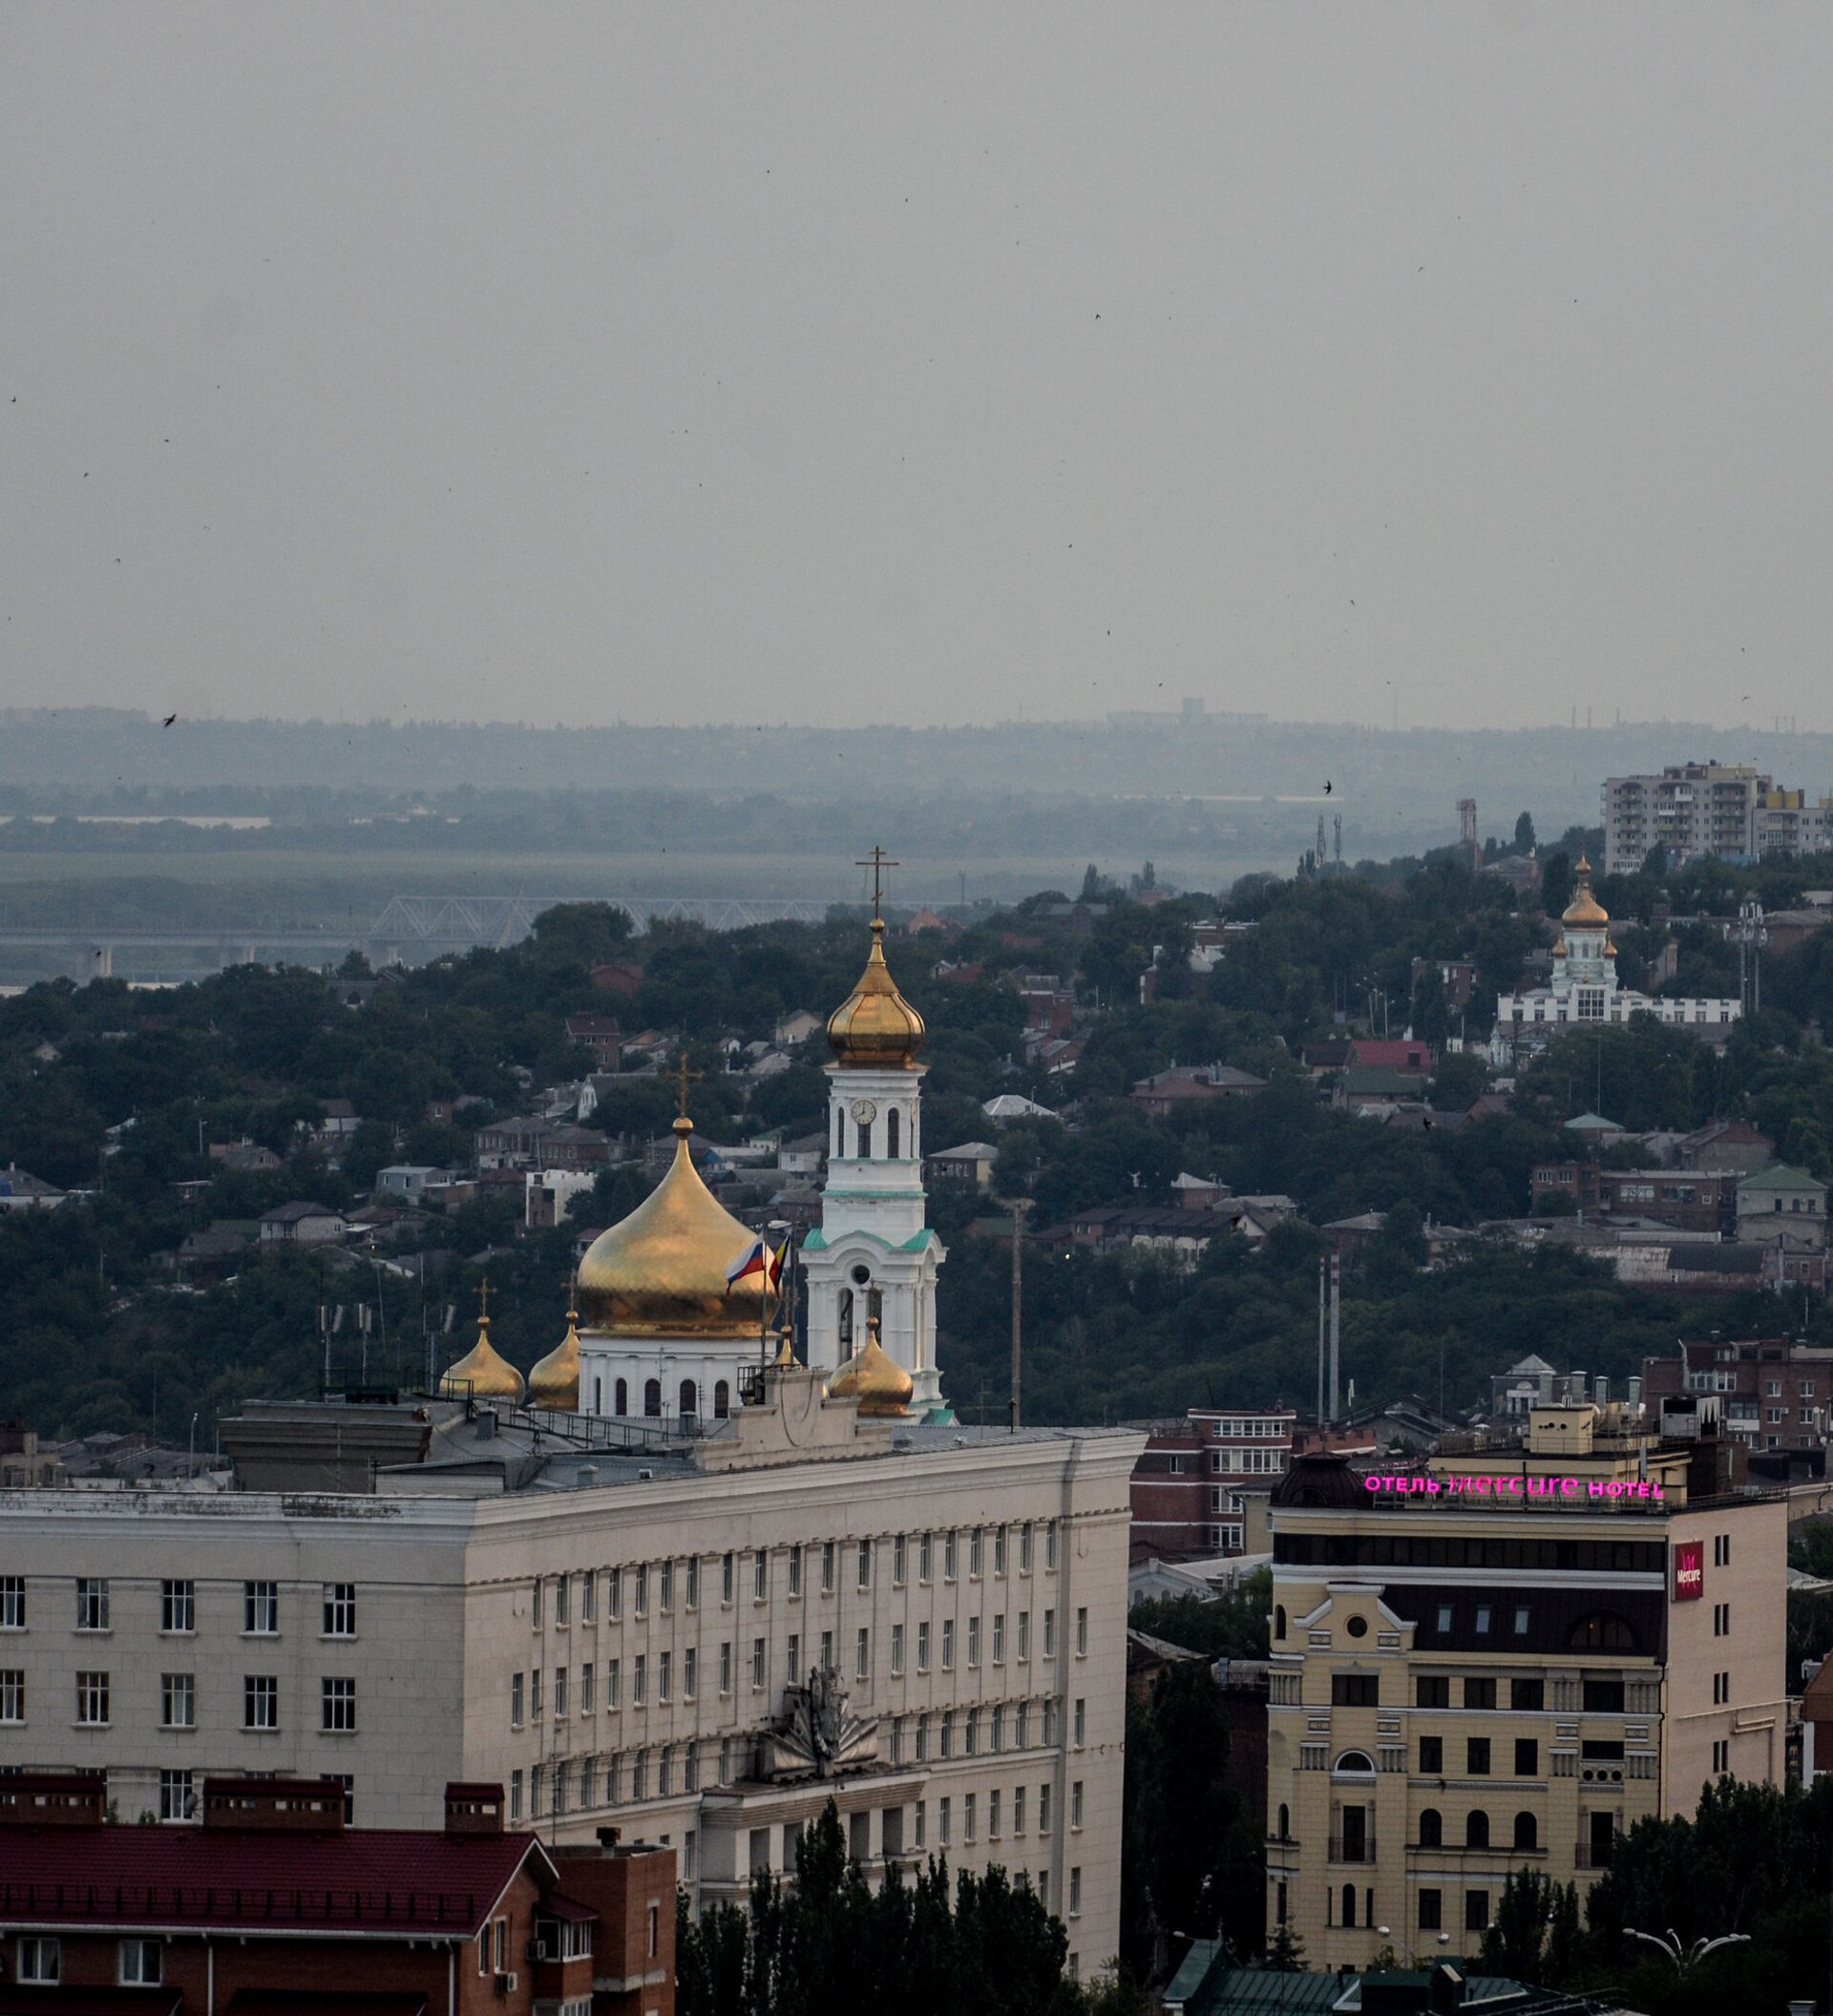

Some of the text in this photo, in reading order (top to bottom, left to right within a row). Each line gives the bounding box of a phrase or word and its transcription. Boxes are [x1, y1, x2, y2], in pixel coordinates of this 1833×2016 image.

[1364, 1475, 1441, 1494] ОТЕЛЬ
[1588, 1480, 1666, 1499] HOTEL
[1677, 1568, 1700, 1584] Mercure
